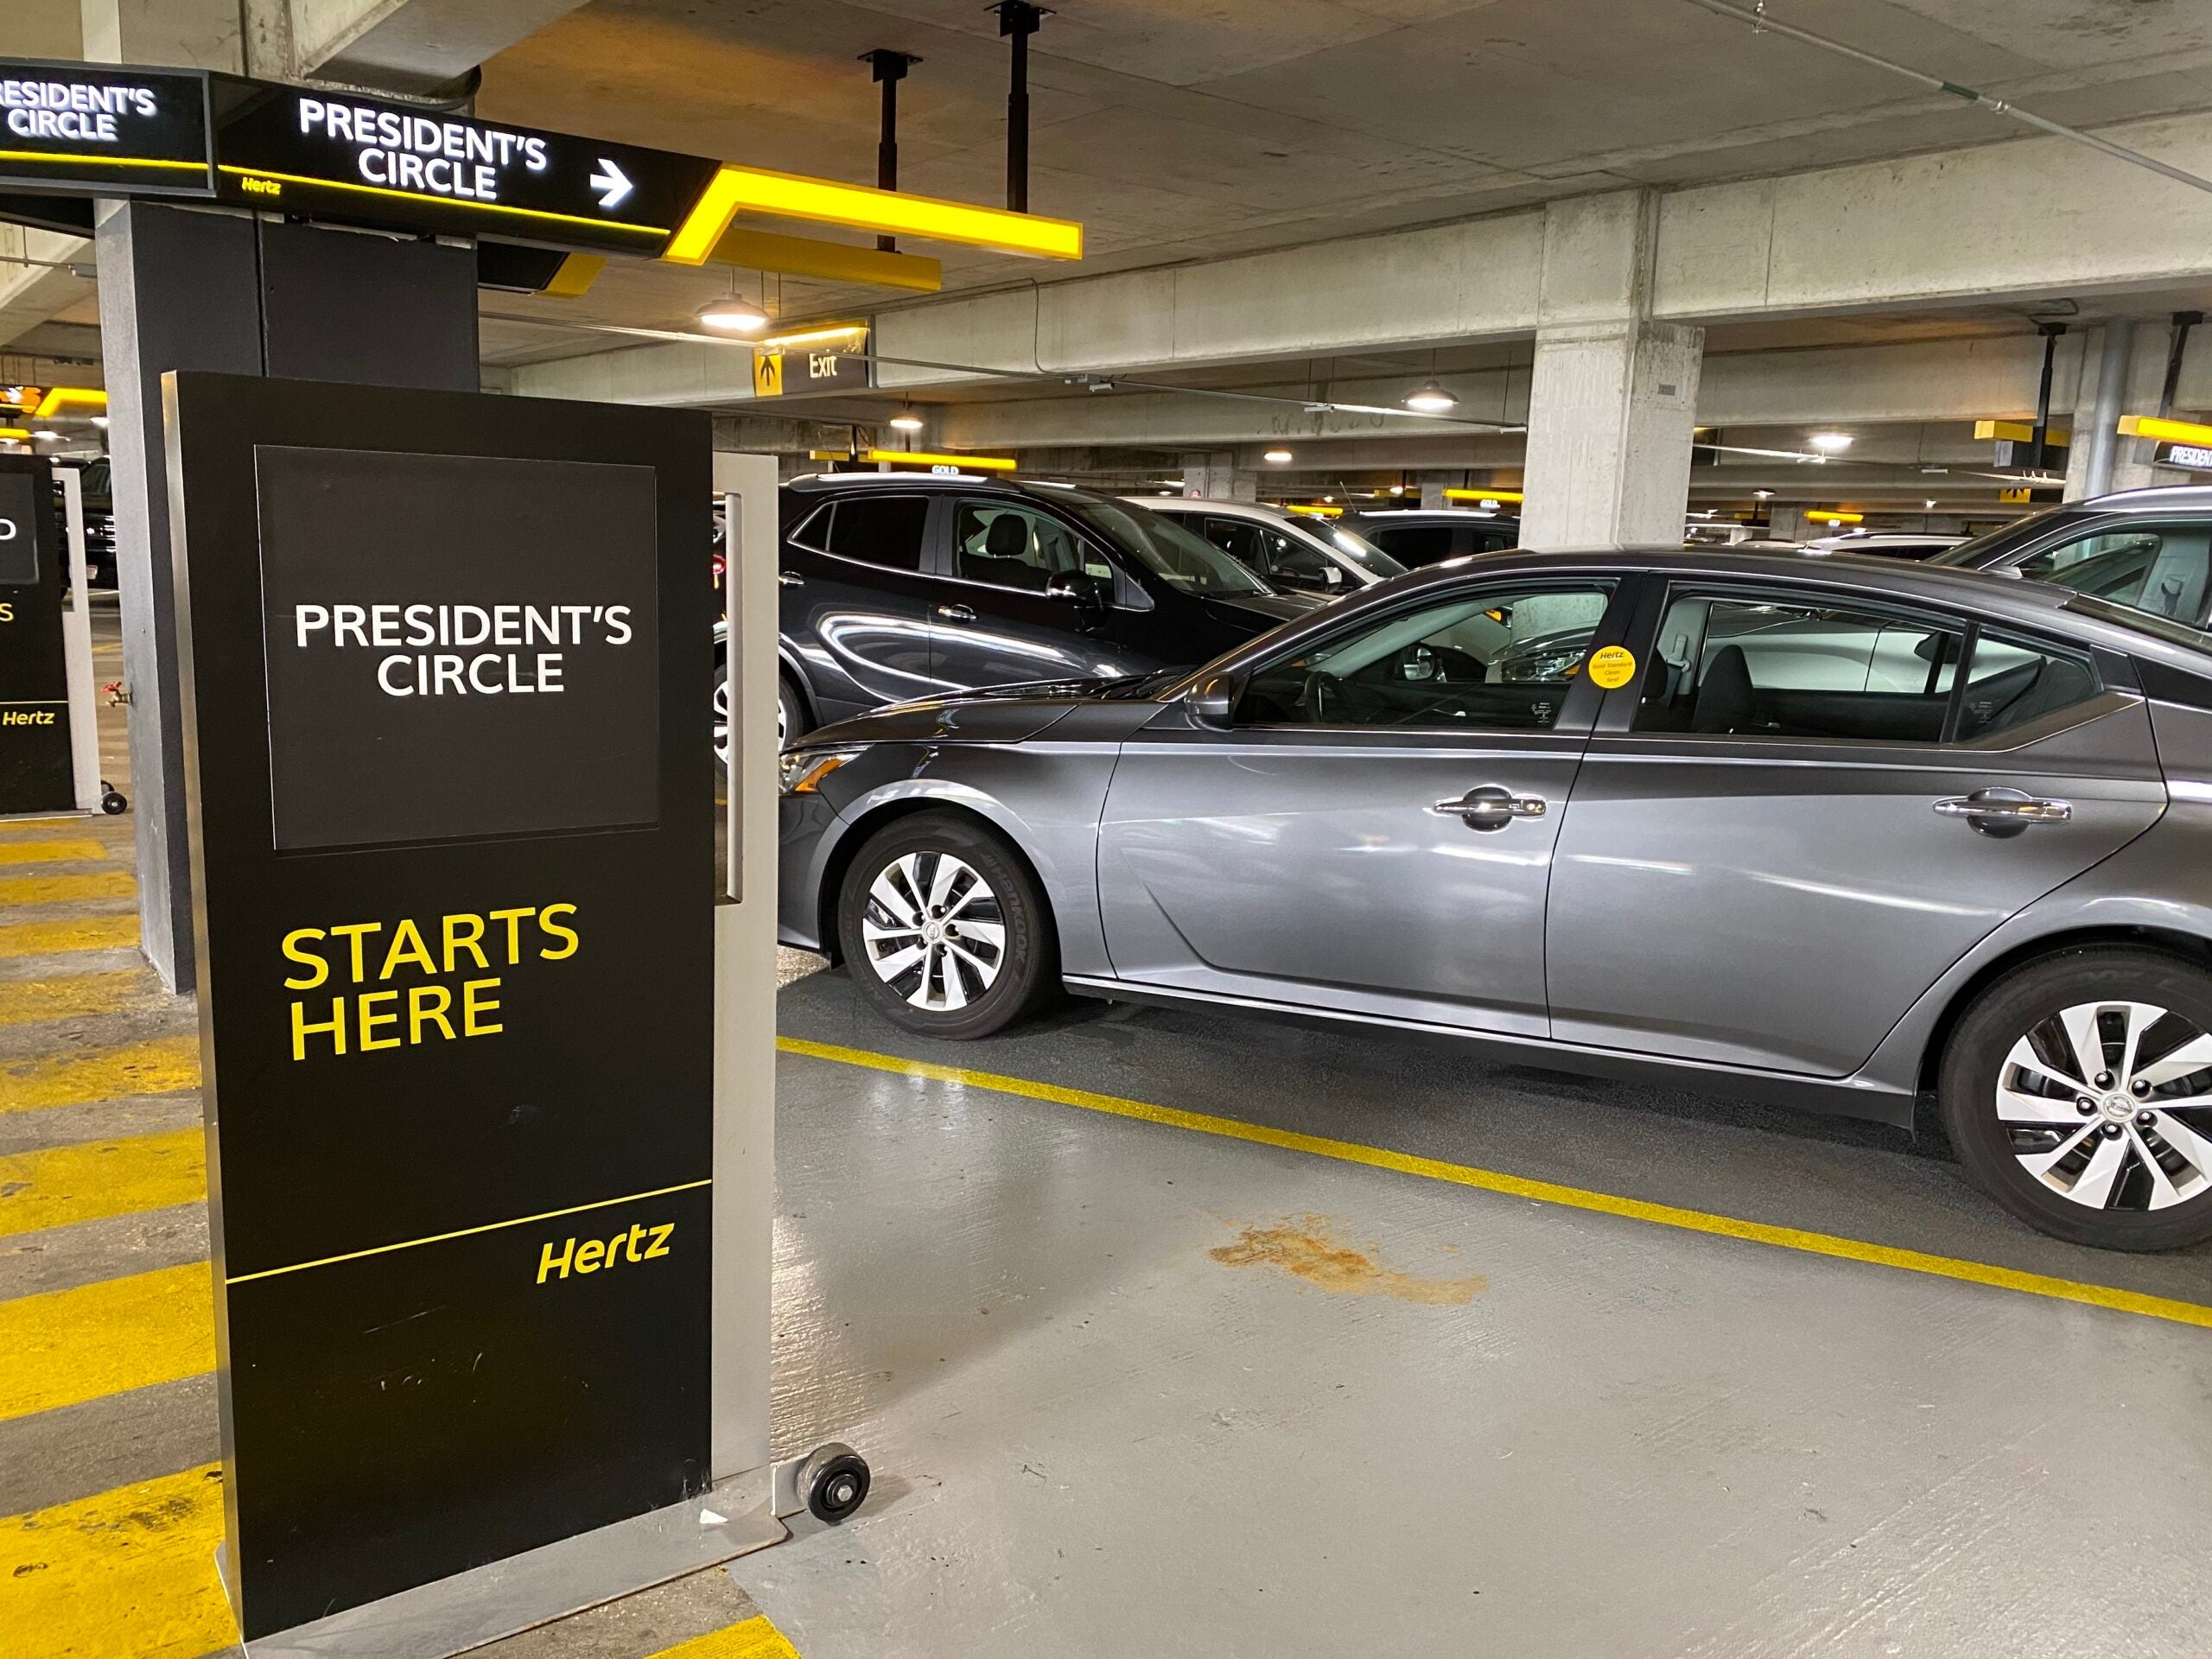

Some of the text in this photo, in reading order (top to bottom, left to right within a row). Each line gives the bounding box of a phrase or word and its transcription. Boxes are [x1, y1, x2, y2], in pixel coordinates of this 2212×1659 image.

[7, 108, 118, 142] CIRCLE
[299, 98, 548, 170] PRESIDENT'S
[242, 176, 282, 195] Hertz
[358, 147, 498, 200] CIRCLE
[809, 353, 837, 378] Exit
[931, 465, 959, 475] GOLD
[296, 604, 632, 647] PRESIDENT'S
[377, 653, 564, 696] CIRCLE
[3, 710, 55, 726] Hertz
[282, 903, 579, 990] STARTS
[291, 977, 503, 1061] HERE
[536, 1222, 675, 1285] Hertz
